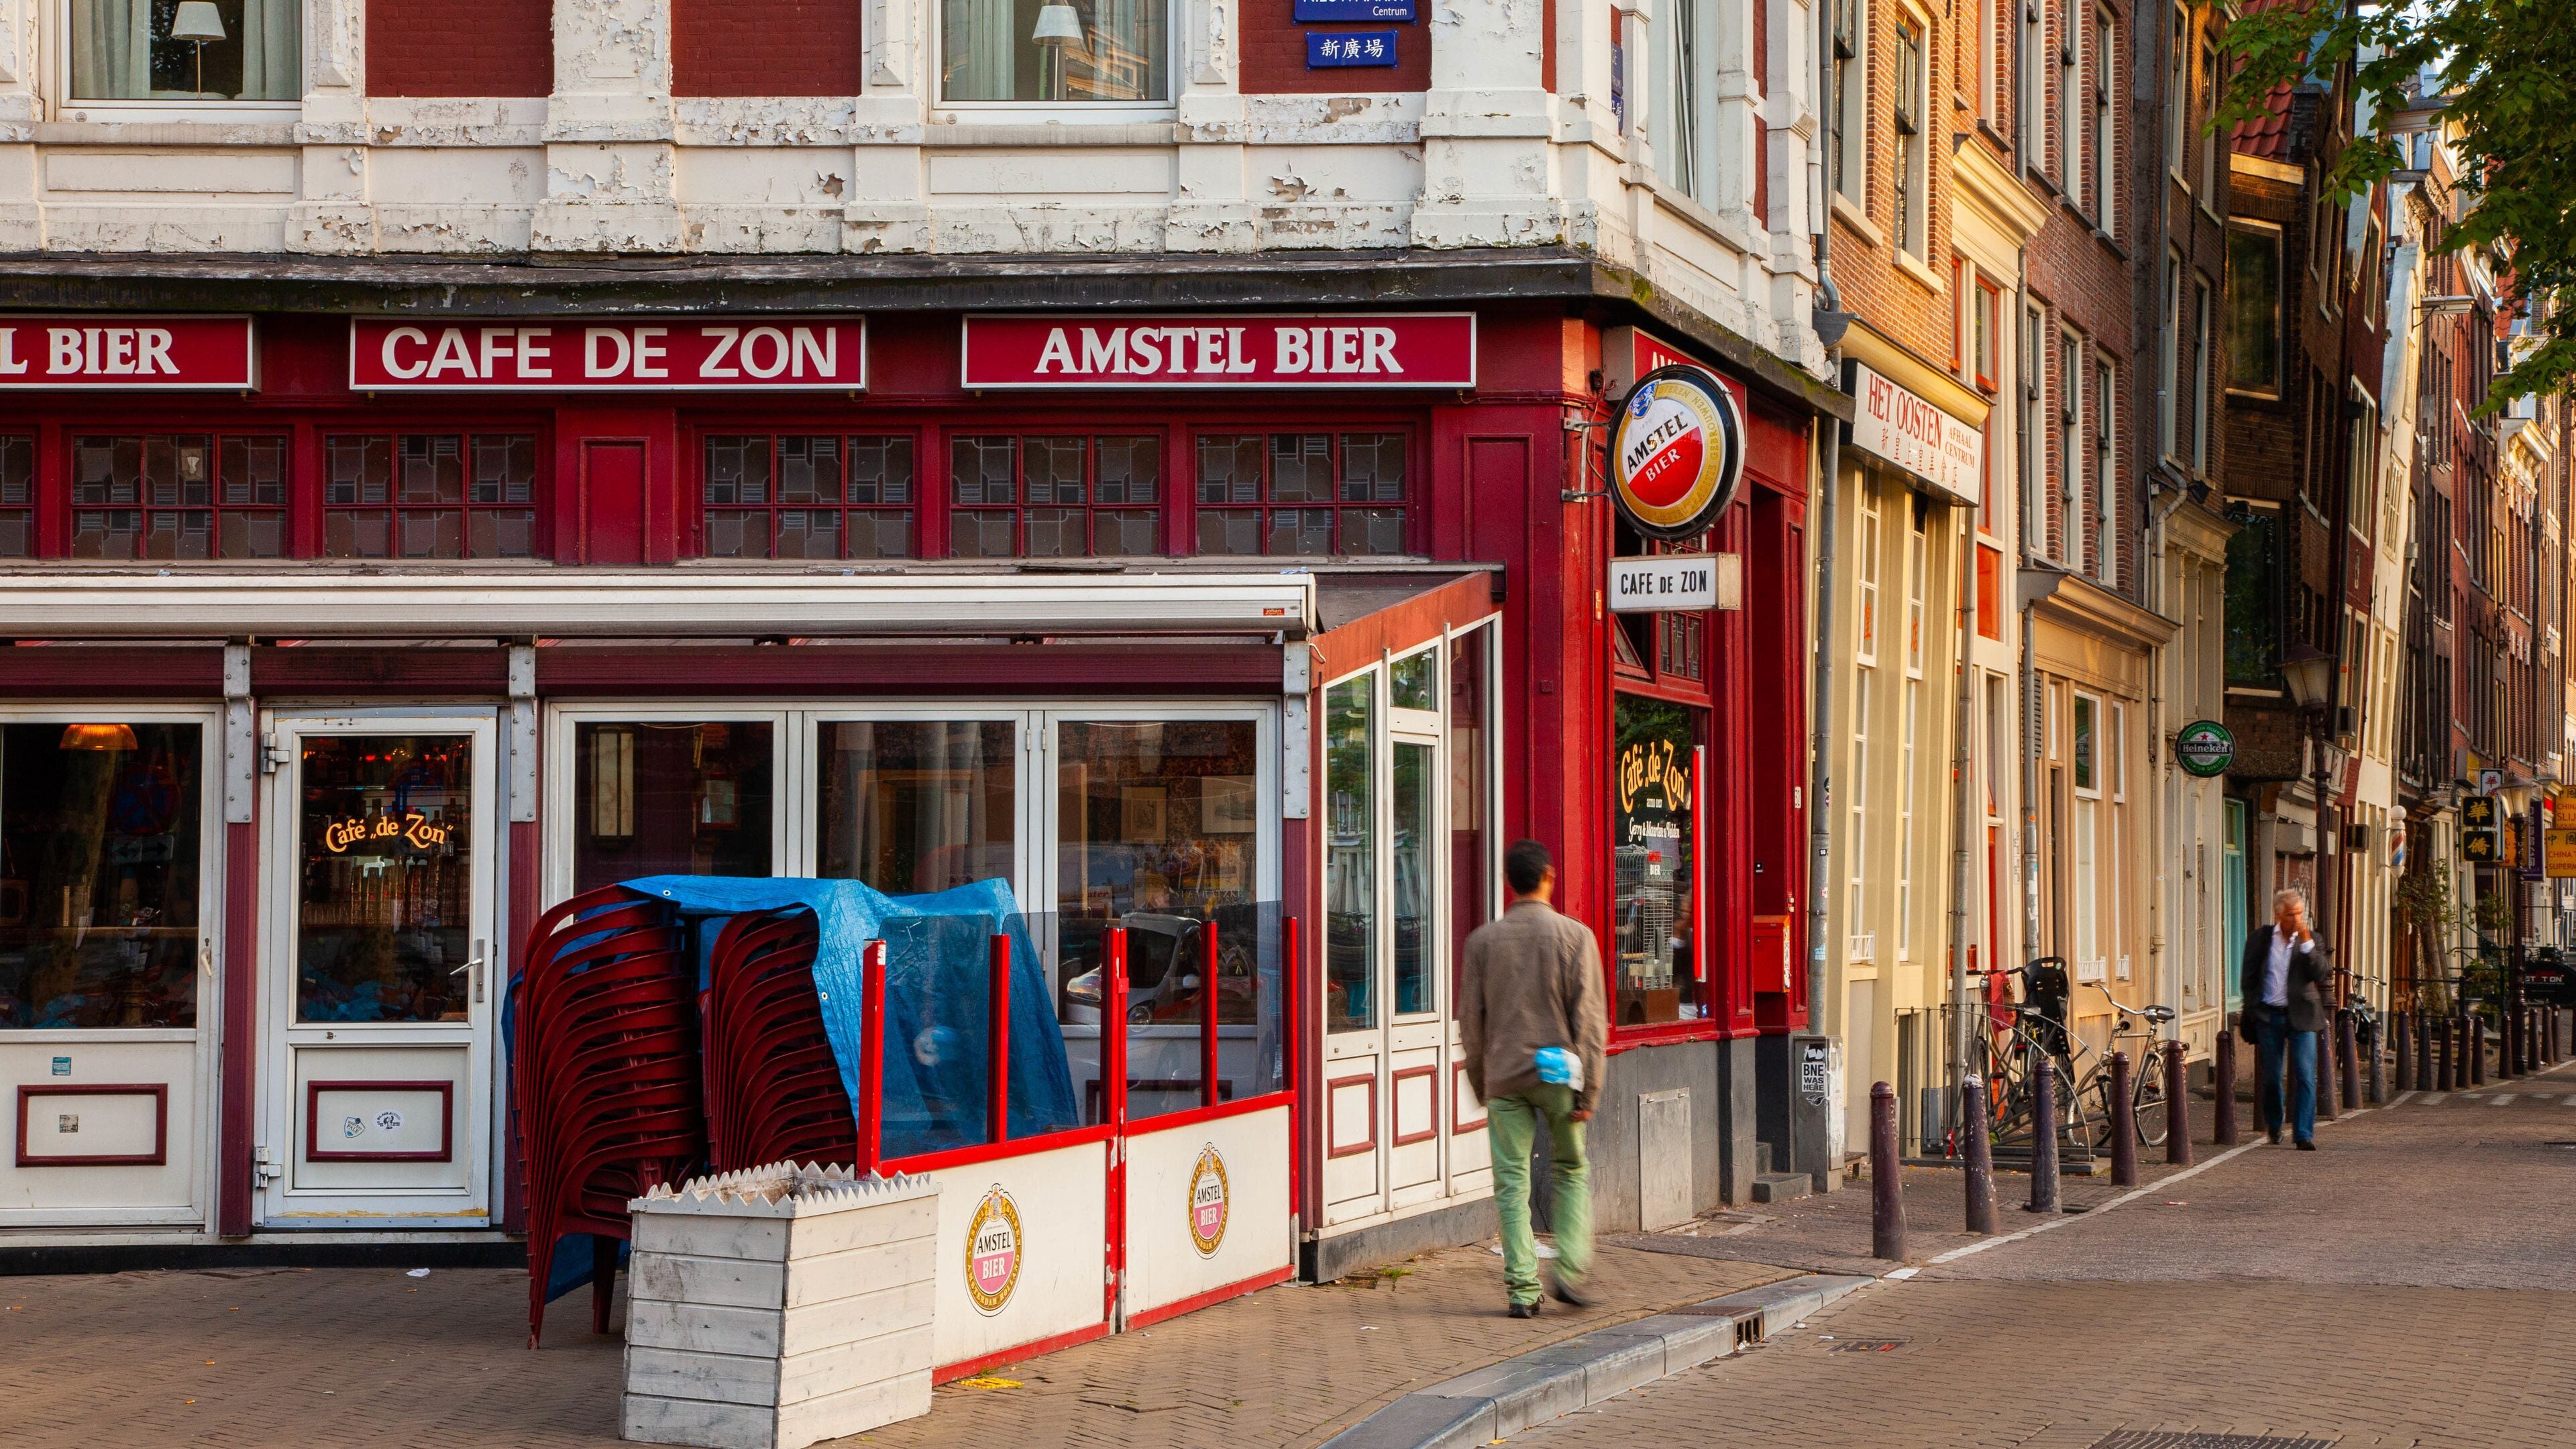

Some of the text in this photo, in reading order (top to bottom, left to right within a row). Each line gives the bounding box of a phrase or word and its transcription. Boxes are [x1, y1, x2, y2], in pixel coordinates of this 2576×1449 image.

[1373, 5, 1407, 16] Centrum
[1320, 38, 1385, 60] 新廣場
[46, 327, 180, 375] BIER
[381, 327, 837, 380] CAFE DE ZON
[1034, 327, 1404, 376] AMSTEL BIER
[1868, 373, 1943, 451] HET OOSTEN
[1627, 413, 1688, 474] AMSTEL
[1948, 427, 1973, 449] AFHAAL
[1645, 447, 1682, 483] BIER
[1945, 441, 1976, 468] CENTRUM
[1621, 570, 1707, 595] CAFE DE ZON
[2182, 744, 2228, 753] Heineken
[1621, 743, 1644, 814] Café
[325, 818, 366, 853] Café
[2548, 851, 2572, 859] CHINA
[1803, 1064, 1824, 1077] BNE
[1196, 1184, 1221, 1204] AMSTEL
[1200, 1207, 1218, 1227] BIER
[977, 1231, 1012, 1254] AMSTEL
[981, 1257, 1007, 1280] BIER
